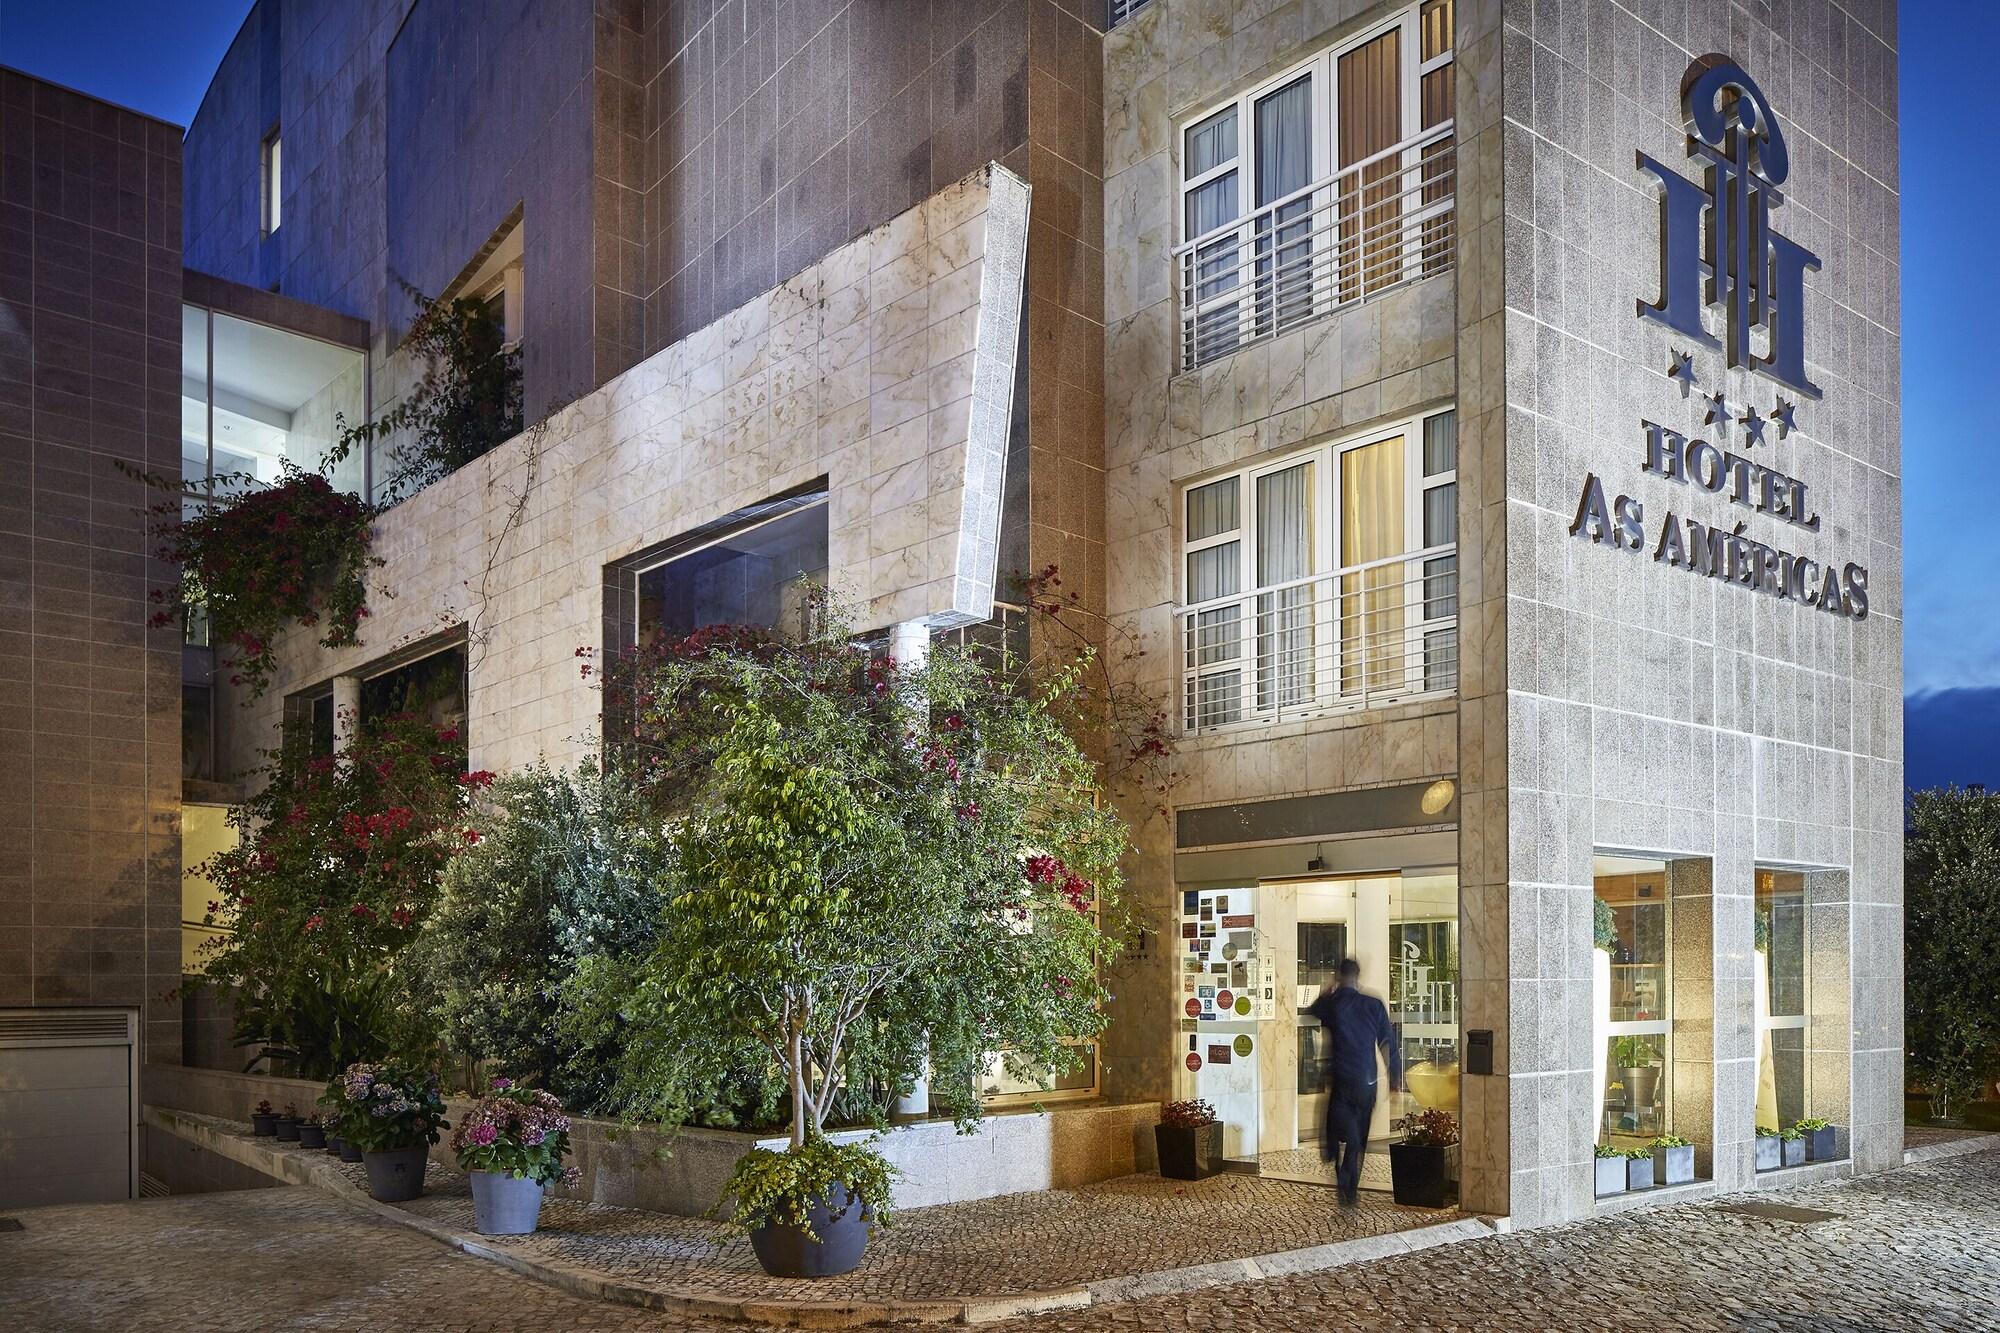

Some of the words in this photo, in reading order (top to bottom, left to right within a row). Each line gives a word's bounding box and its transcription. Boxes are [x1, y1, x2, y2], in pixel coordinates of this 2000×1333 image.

[1642, 419, 1820, 532] HOTEL
[1569, 472, 1644, 553] AS
[1653, 511, 1869, 621] AMÉRICAS
